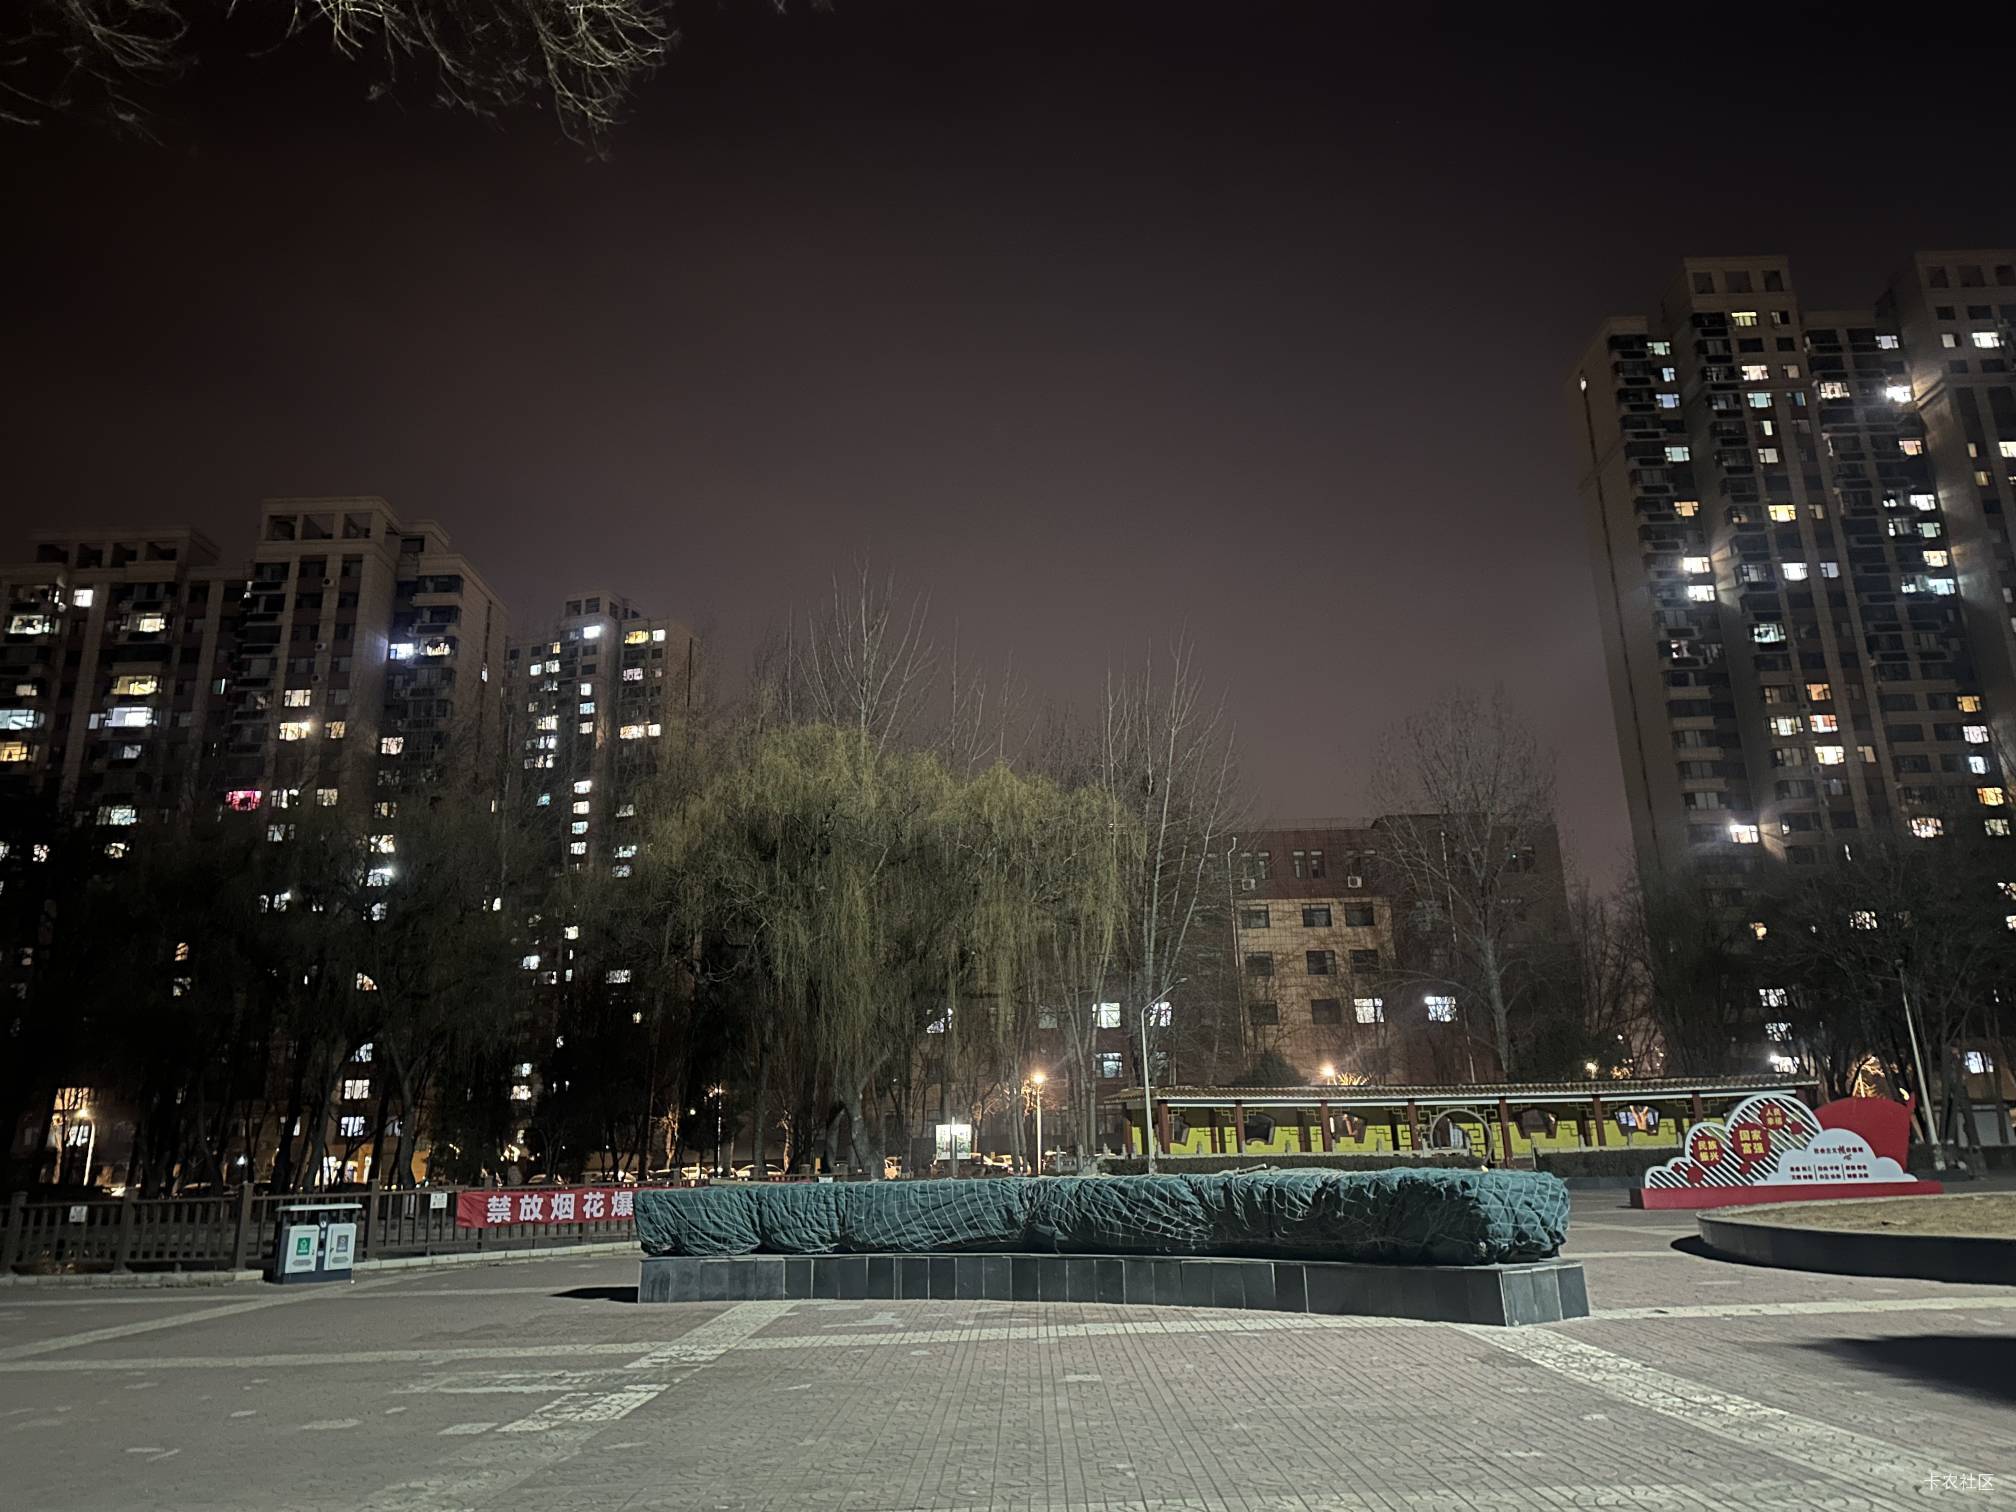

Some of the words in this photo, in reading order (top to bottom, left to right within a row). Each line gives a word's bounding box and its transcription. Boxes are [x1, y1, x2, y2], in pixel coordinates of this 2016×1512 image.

[1739, 1129, 1762, 1141] 国家
[1698, 1140, 1718, 1150] 民族
[1741, 1142, 1764, 1154] 富强
[486, 1190, 633, 1223] 禁放烟花爆
